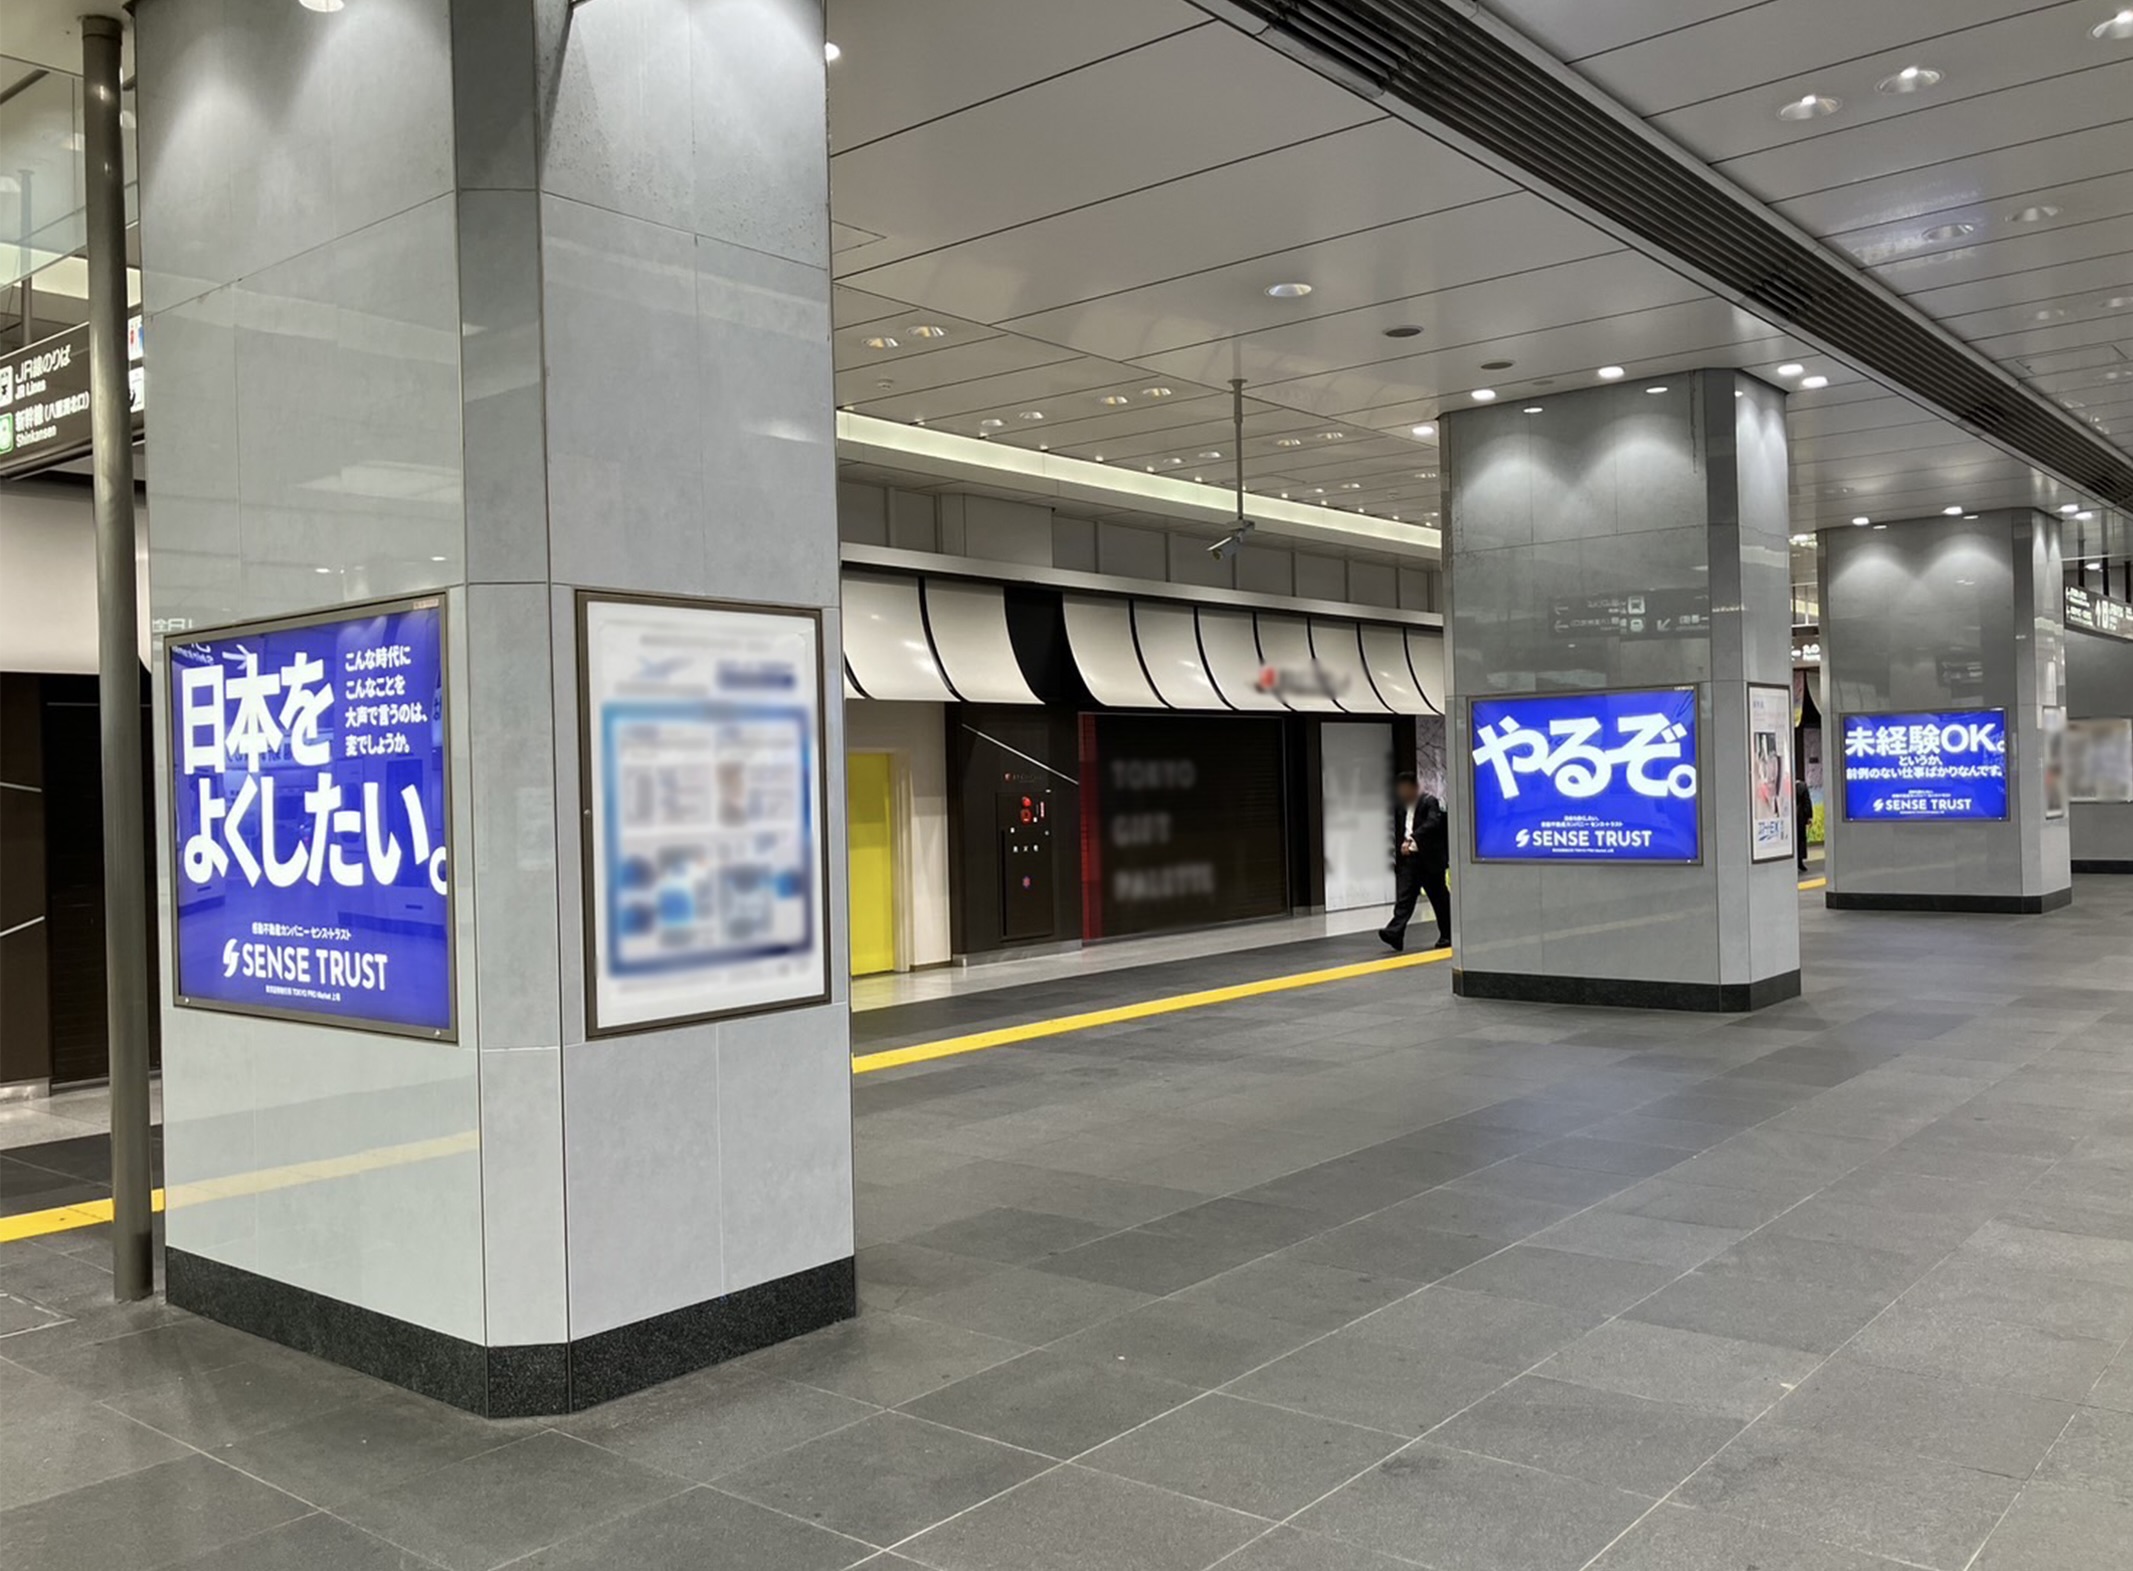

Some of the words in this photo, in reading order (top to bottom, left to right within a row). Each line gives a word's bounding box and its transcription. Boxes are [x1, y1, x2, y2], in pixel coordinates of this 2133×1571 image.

[345, 645, 411, 672] こんな時代に
[345, 674, 406, 700] こんなことを
[182, 652, 335, 774] 日本を
[345, 702, 428, 728] 大声で言うのは、
[345, 732, 410, 757] 変でしょうか。
[1845, 723, 2005, 758] 未経験OK。
[1472, 712, 1697, 799] やるぞ。
[1899, 755, 1943, 766] というか、
[1846, 765, 2003, 780] 前例のない仕事ばかりなんです。
[1885, 799, 1927, 811] SENSE
[1931, 799, 1972, 810] TRUST
[183, 773, 447, 895] よくしたい。
[1532, 830, 1590, 846] SENSE
[1594, 830, 1653, 847] TRUST
[242, 943, 311, 983] SENSE
[315, 948, 388, 991] TRUST
